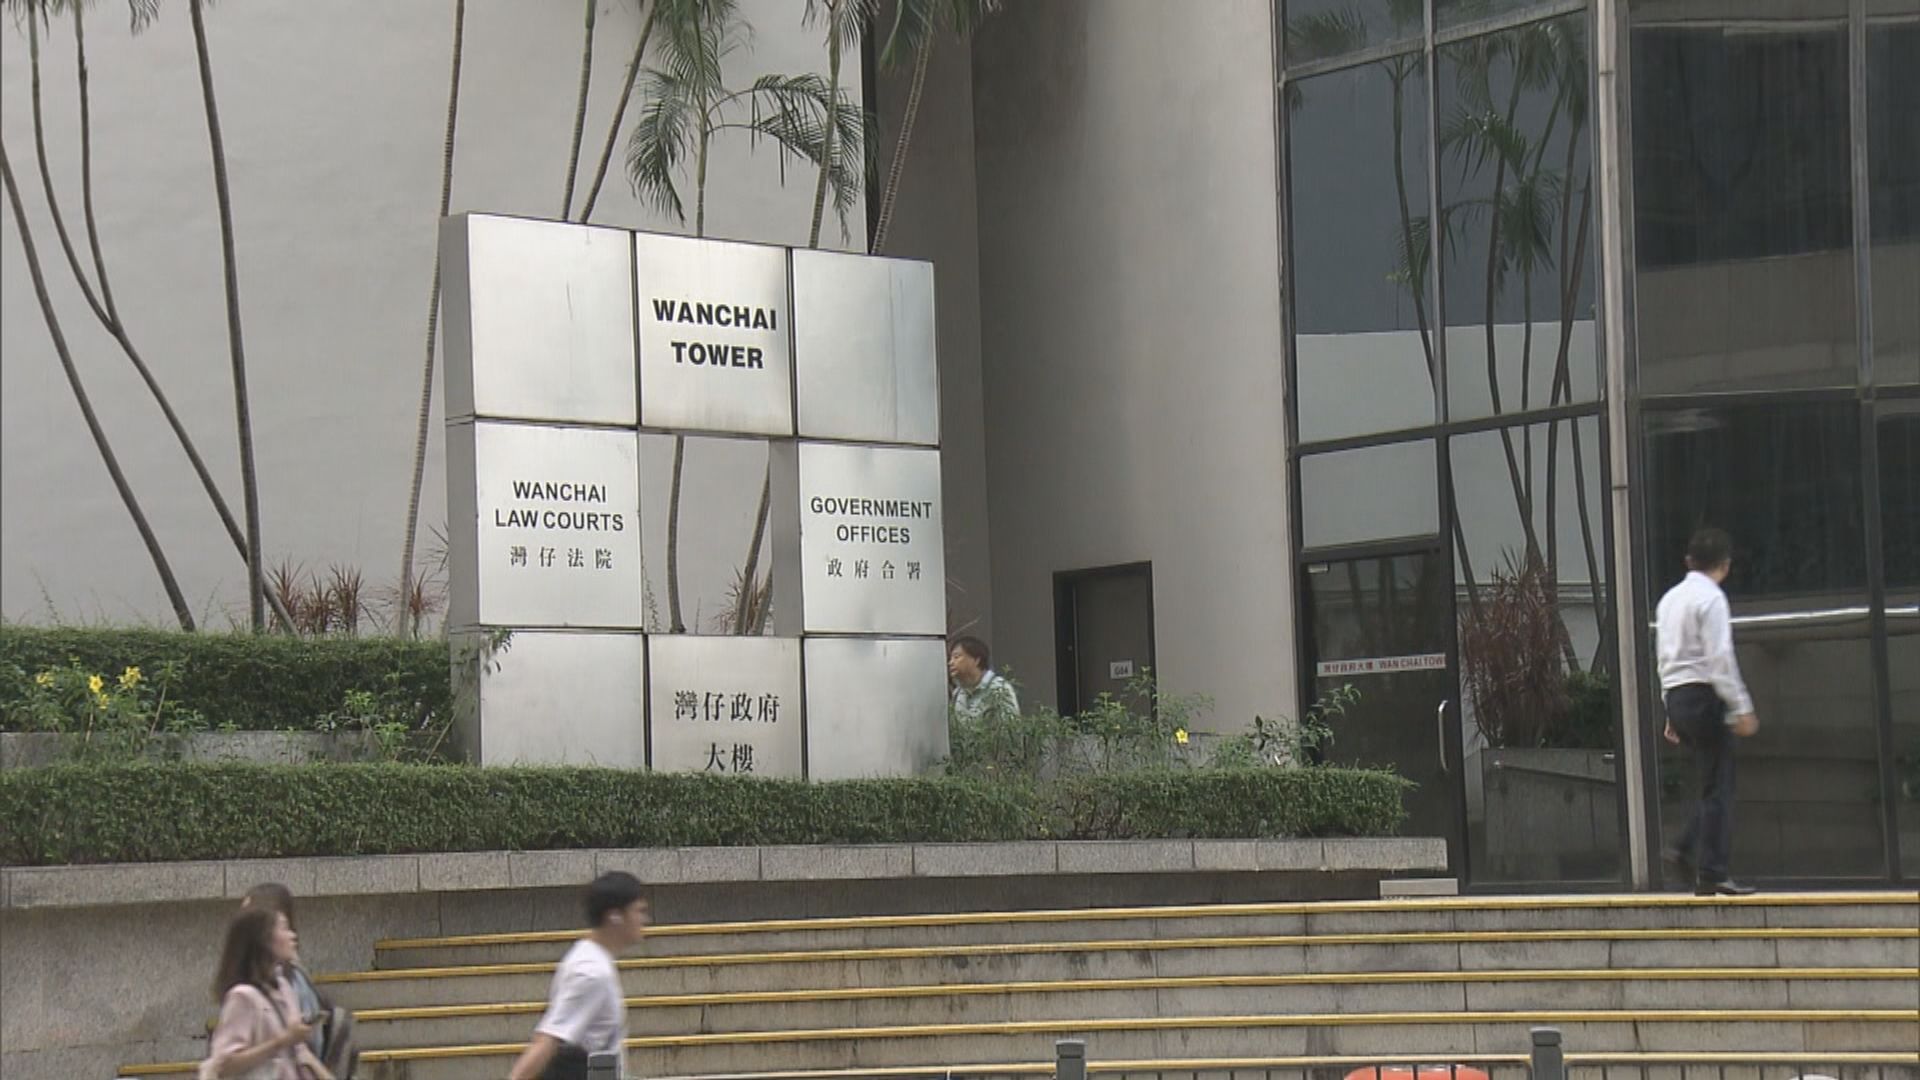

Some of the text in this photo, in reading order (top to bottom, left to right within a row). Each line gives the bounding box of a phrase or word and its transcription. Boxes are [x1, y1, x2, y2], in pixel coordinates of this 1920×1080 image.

[652, 299, 777, 331] WANCHAI
[671, 341, 764, 369] TOWER
[513, 481, 606, 503] WANCHAI
[811, 496, 932, 520] GOVERNMENT
[495, 509, 624, 531] LAW COURTS
[836, 525, 910, 545] OFFICES
[510, 546, 612, 569] 灣仔法院
[827, 558, 921, 580] 政府合署
[674, 691, 780, 723] 灣仔政府
[704, 742, 754, 773] 大樓
